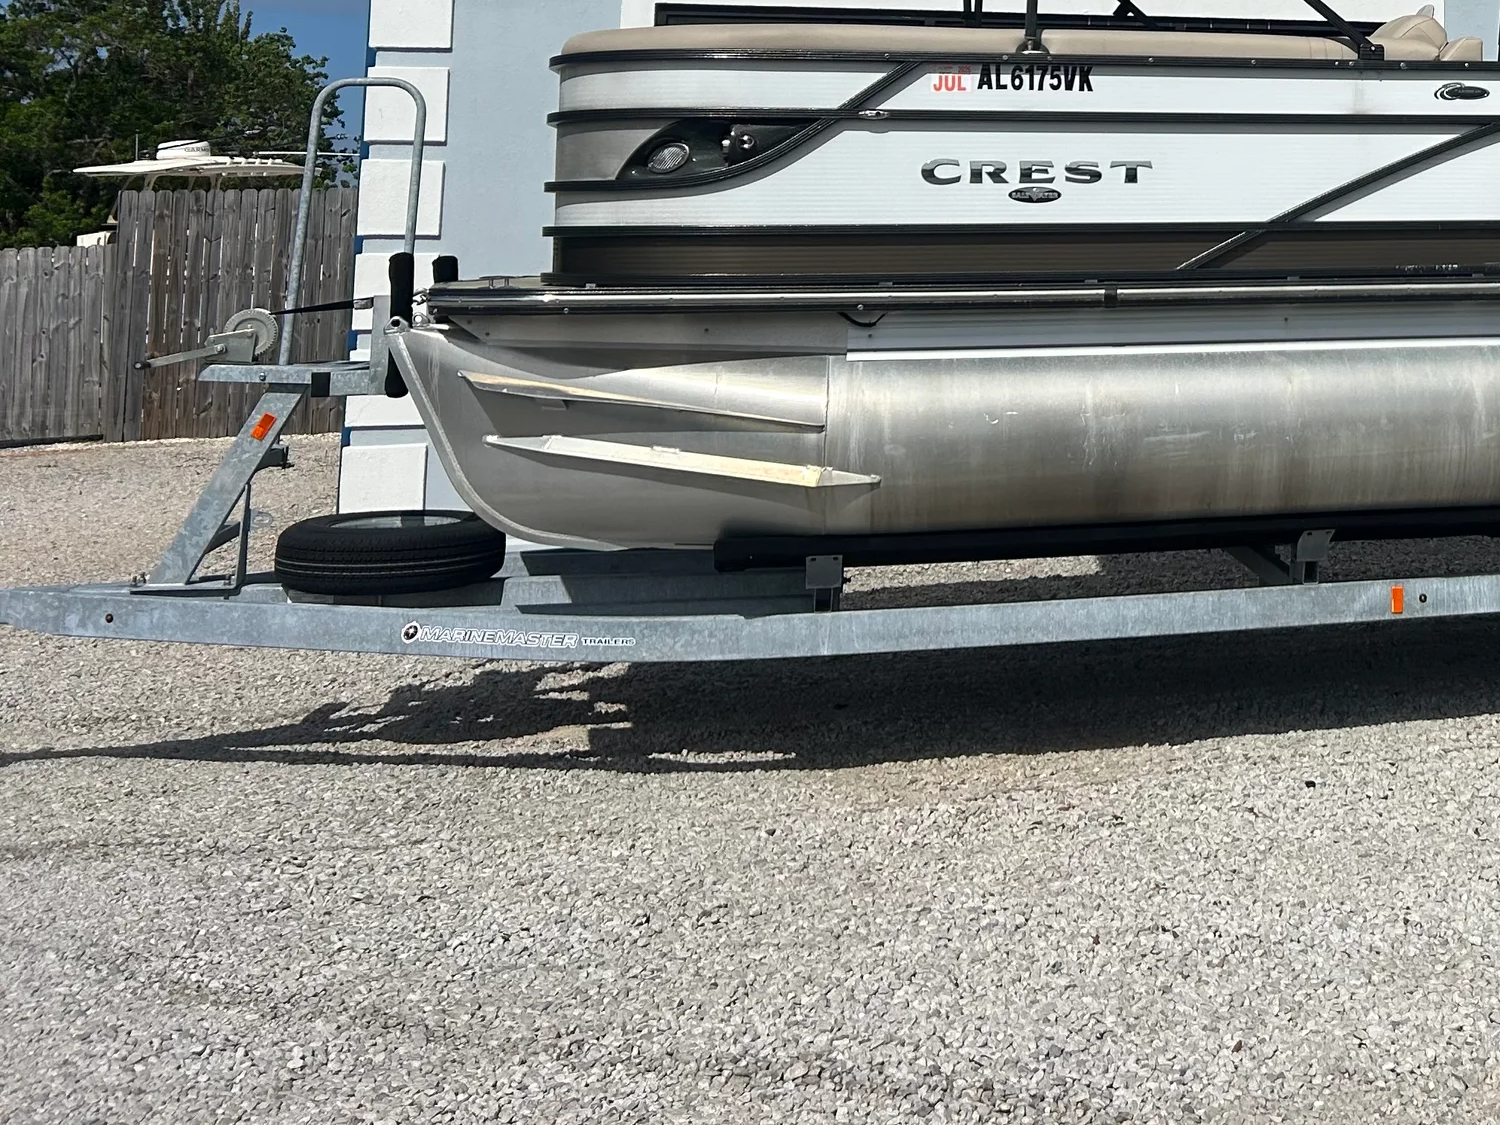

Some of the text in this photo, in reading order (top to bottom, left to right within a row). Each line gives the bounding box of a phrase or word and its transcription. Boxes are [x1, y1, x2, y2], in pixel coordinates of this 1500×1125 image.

[933, 74, 966, 92] JUL
[920, 158, 1153, 185] CREST
[419, 625, 636, 648] MARINEMASTER TRAILERS
